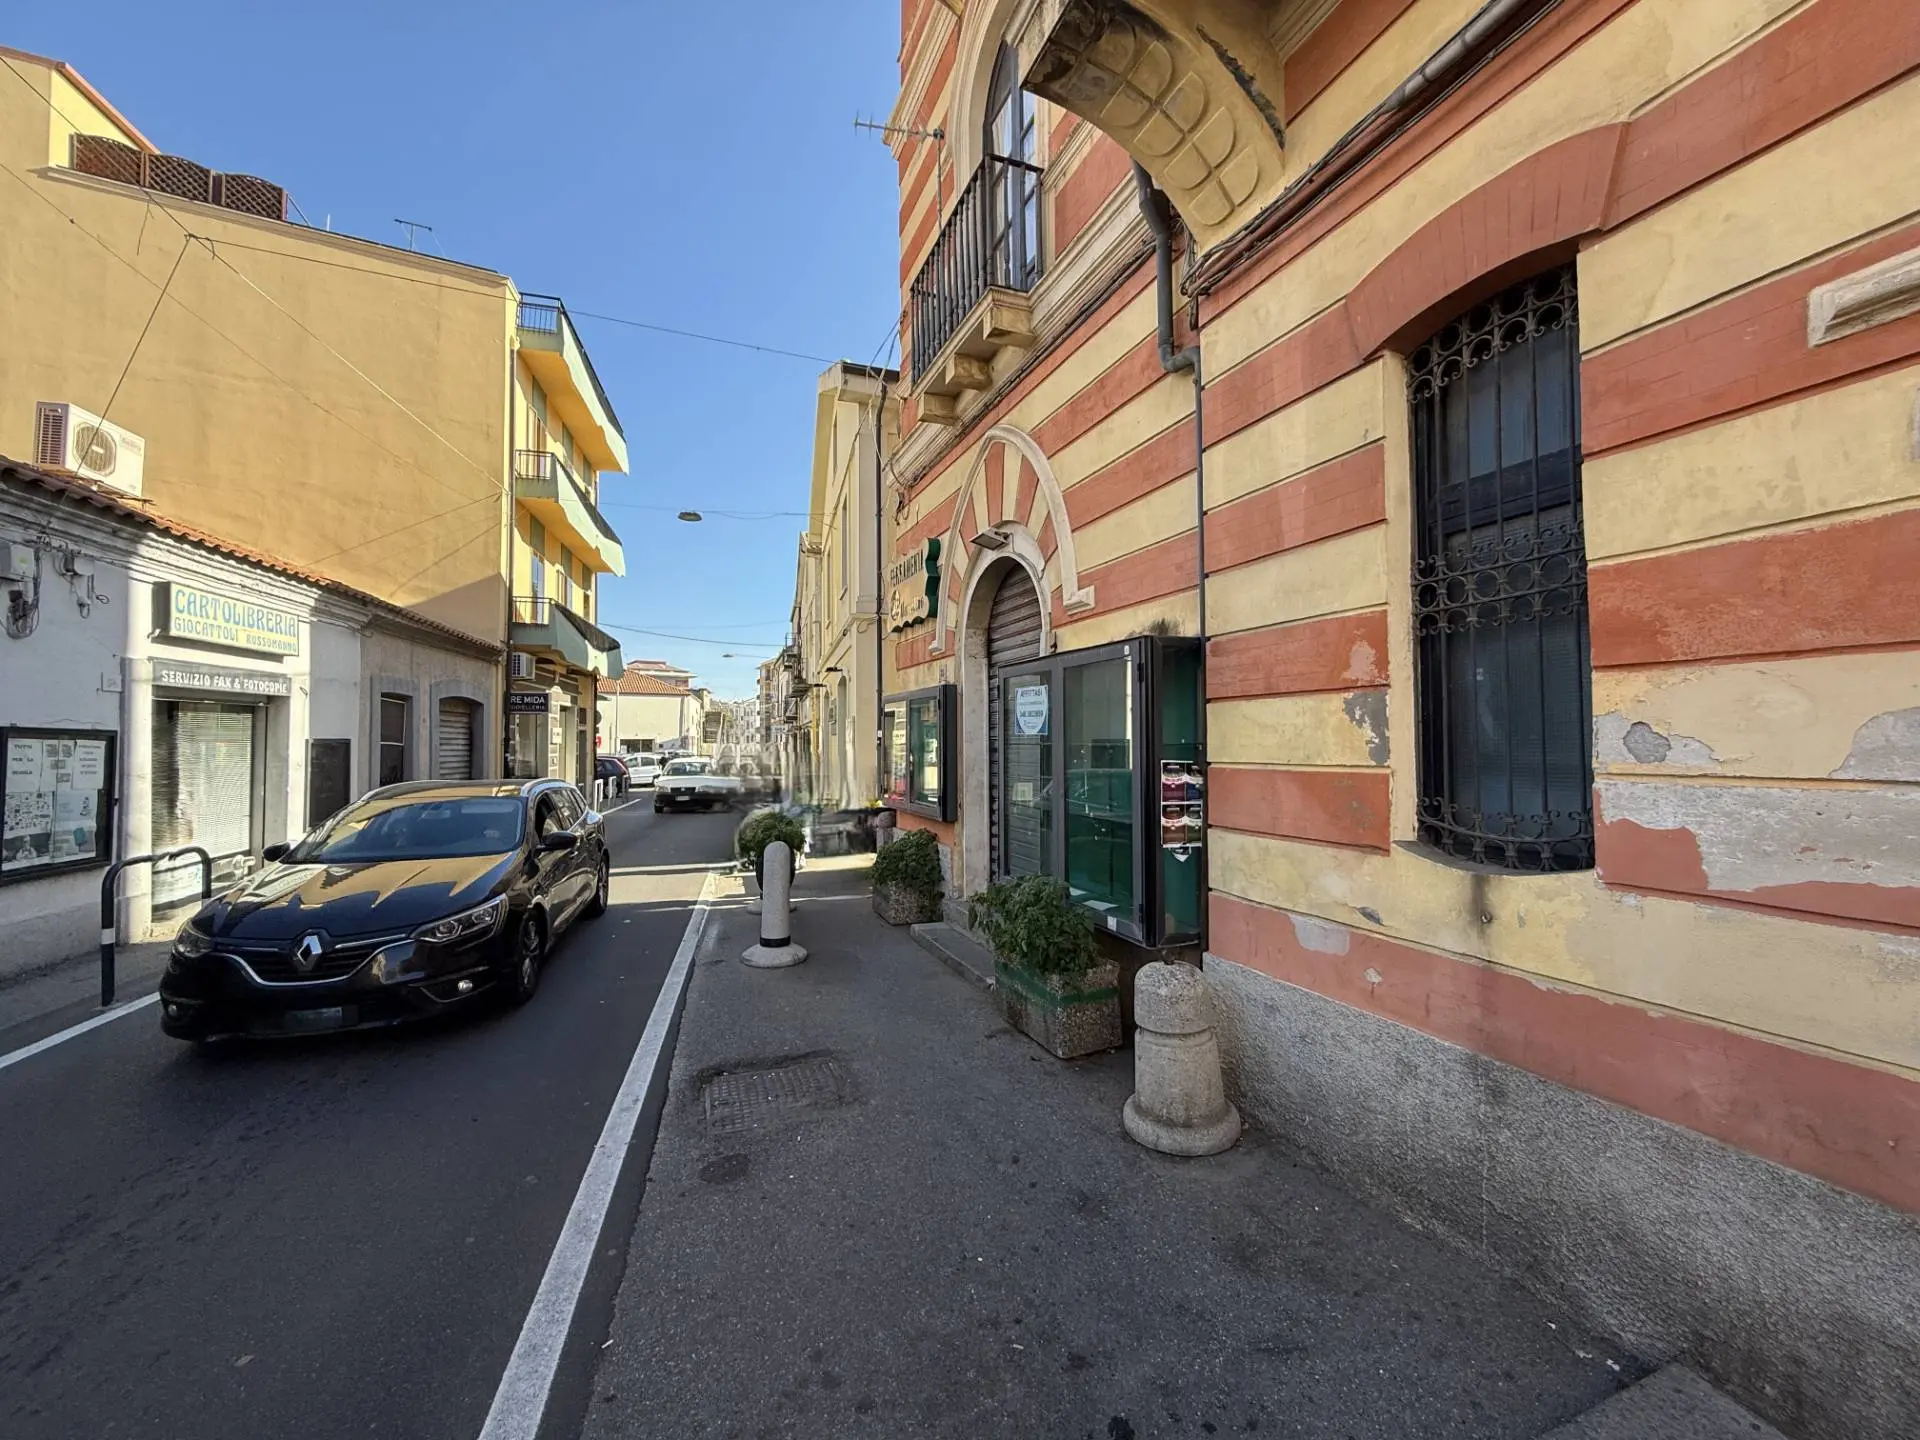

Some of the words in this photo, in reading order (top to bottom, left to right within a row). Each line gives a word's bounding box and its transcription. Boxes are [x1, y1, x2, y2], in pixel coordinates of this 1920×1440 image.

[175, 589, 296, 637] CARTOLIBRERIA
[174, 616, 239, 642] GIOCATTOLI
[161, 670, 210, 686] SERVIZIO
[213, 675, 231, 688] FAX
[233, 678, 241, 689] &
[243, 679, 287, 693] FOTOCOPIE
[510, 695, 522, 704] RE
[523, 695, 545, 704] MIDA
